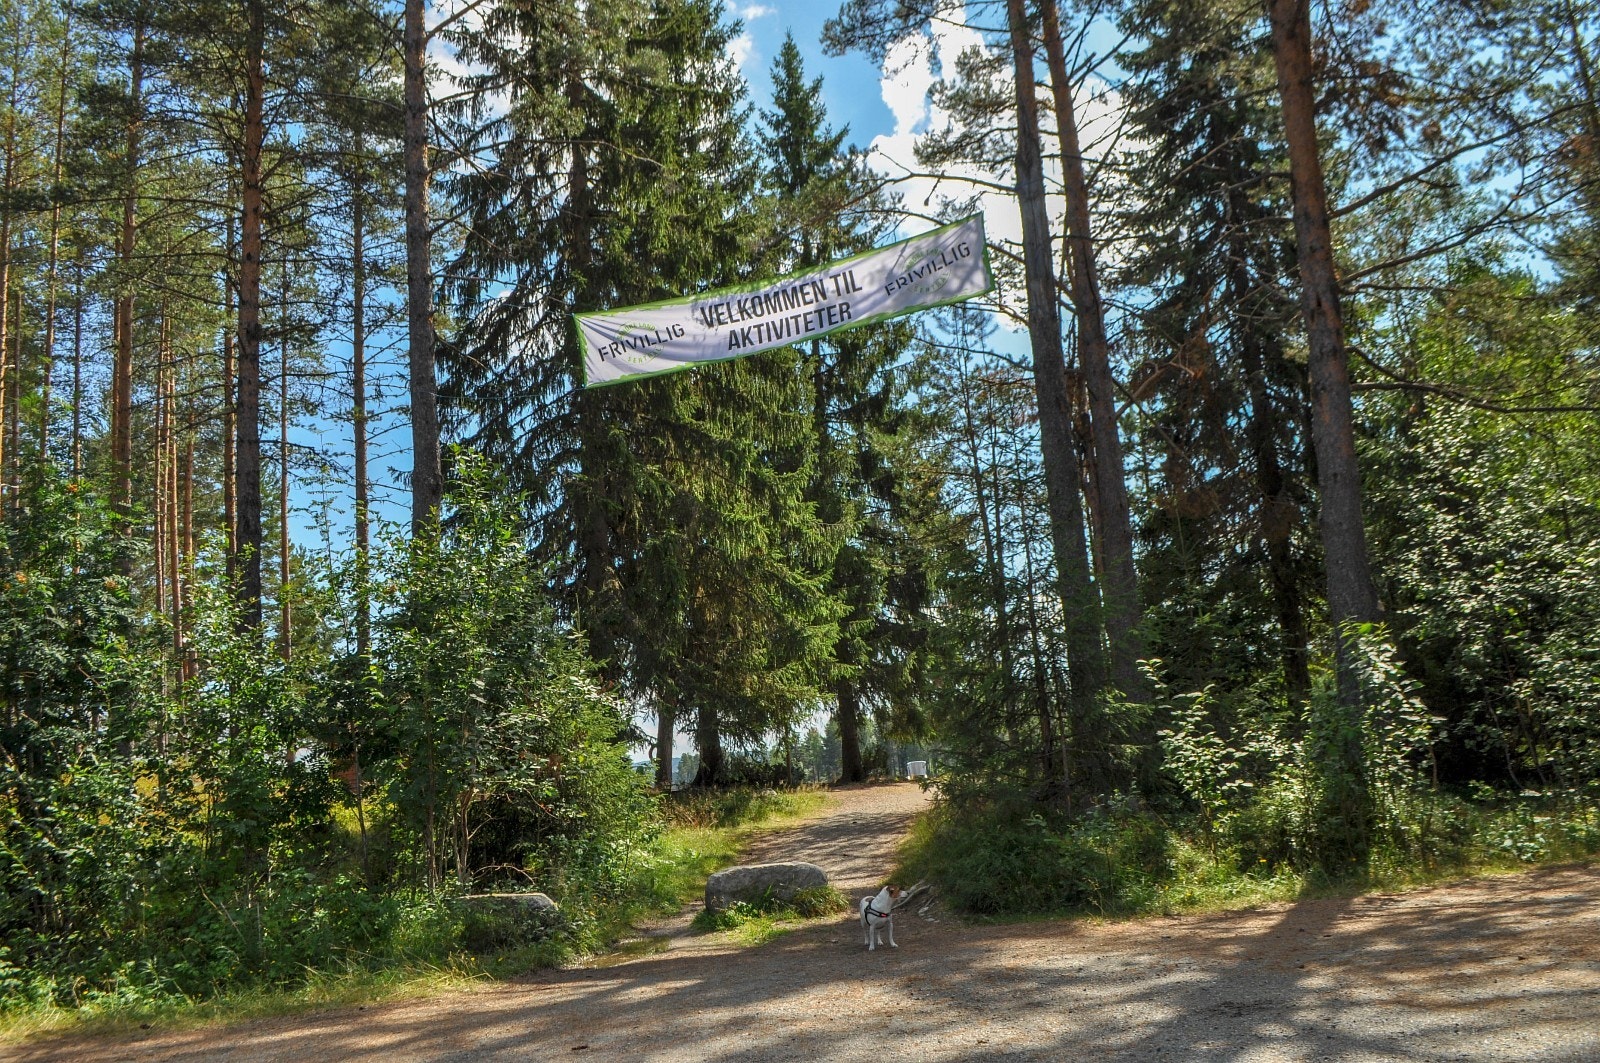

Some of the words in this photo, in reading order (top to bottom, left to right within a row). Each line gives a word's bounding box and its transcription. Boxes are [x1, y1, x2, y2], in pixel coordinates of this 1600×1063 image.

[885, 242, 971, 296] FRIVILLIG
[700, 279, 827, 328] VELKOMMEN
[829, 269, 862, 297] TIL
[598, 323, 685, 361] FRIVILLIG
[728, 301, 852, 350] AKTIVITETER
